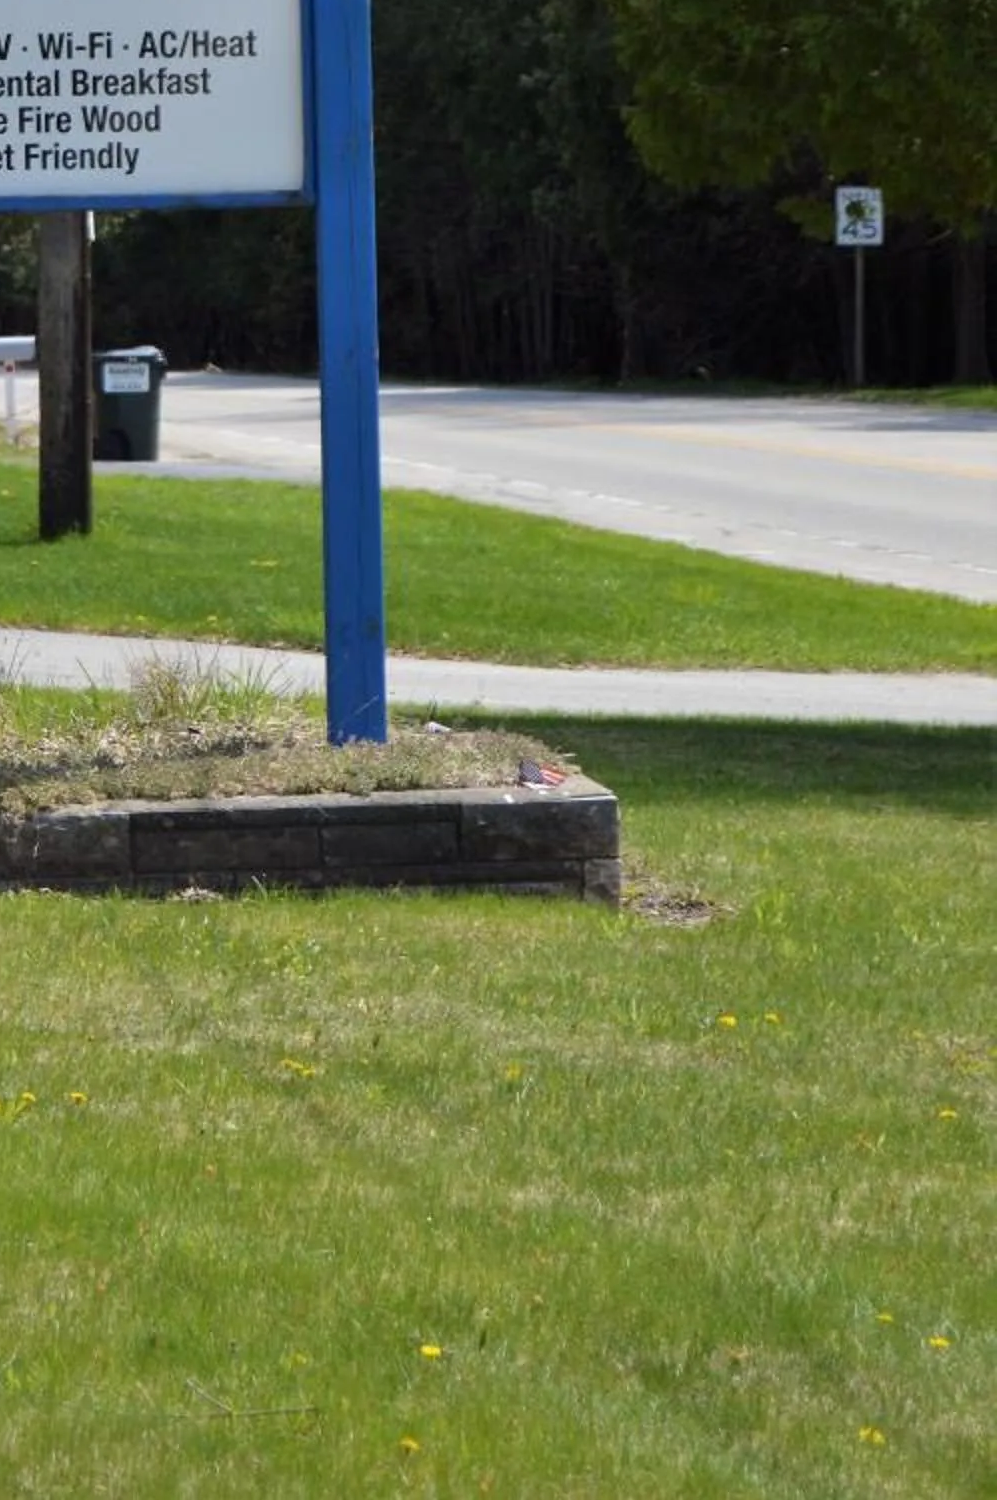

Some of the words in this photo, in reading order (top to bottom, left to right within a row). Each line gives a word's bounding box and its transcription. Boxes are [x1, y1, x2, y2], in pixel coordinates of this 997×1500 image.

[37, 32, 113, 60] Wi-Fi
[138, 30, 257, 59] AC/Heat
[72, 67, 211, 97] Breakfast
[18, 106, 72, 134] Fire
[82, 105, 161, 132] Wood
[23, 142, 140, 175] Friendly
[842, 219, 877, 238] 45
